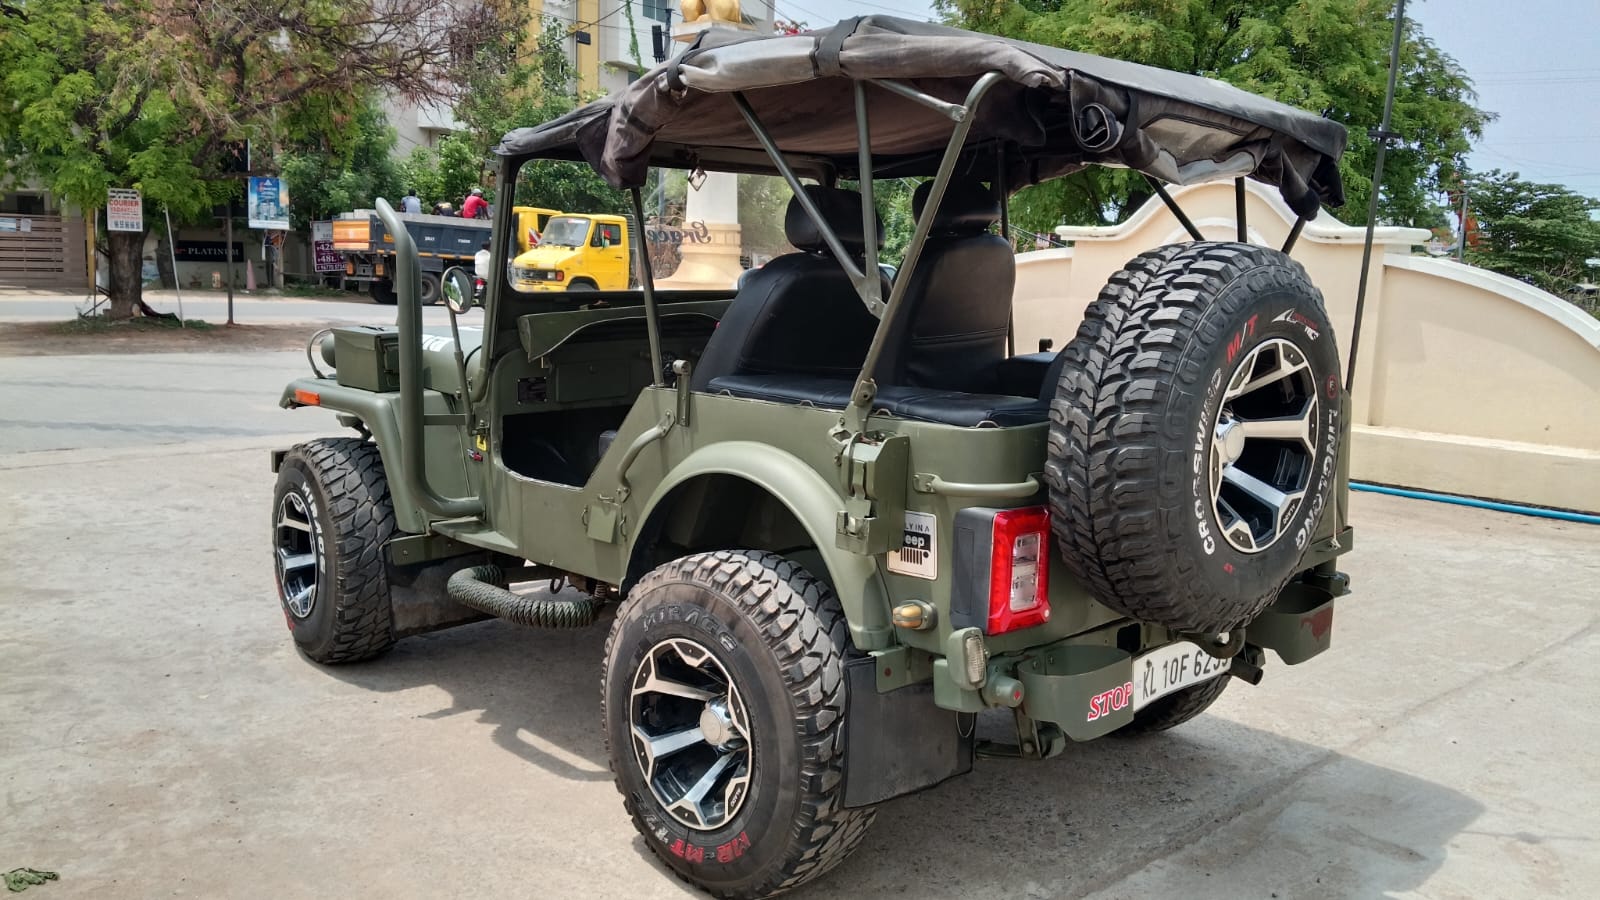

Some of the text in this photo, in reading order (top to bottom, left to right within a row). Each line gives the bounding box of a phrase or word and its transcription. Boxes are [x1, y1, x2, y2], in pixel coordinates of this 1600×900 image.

[1193, 367, 1222, 555] CROSSWIND
[1296, 408, 1338, 551] LINGLONG
[905, 534, 925, 549] eep
[915, 524, 923, 532] IN
[1142, 666, 1156, 700] KL
[1163, 653, 1190, 689] 10F
[1087, 681, 1133, 722] STOP
